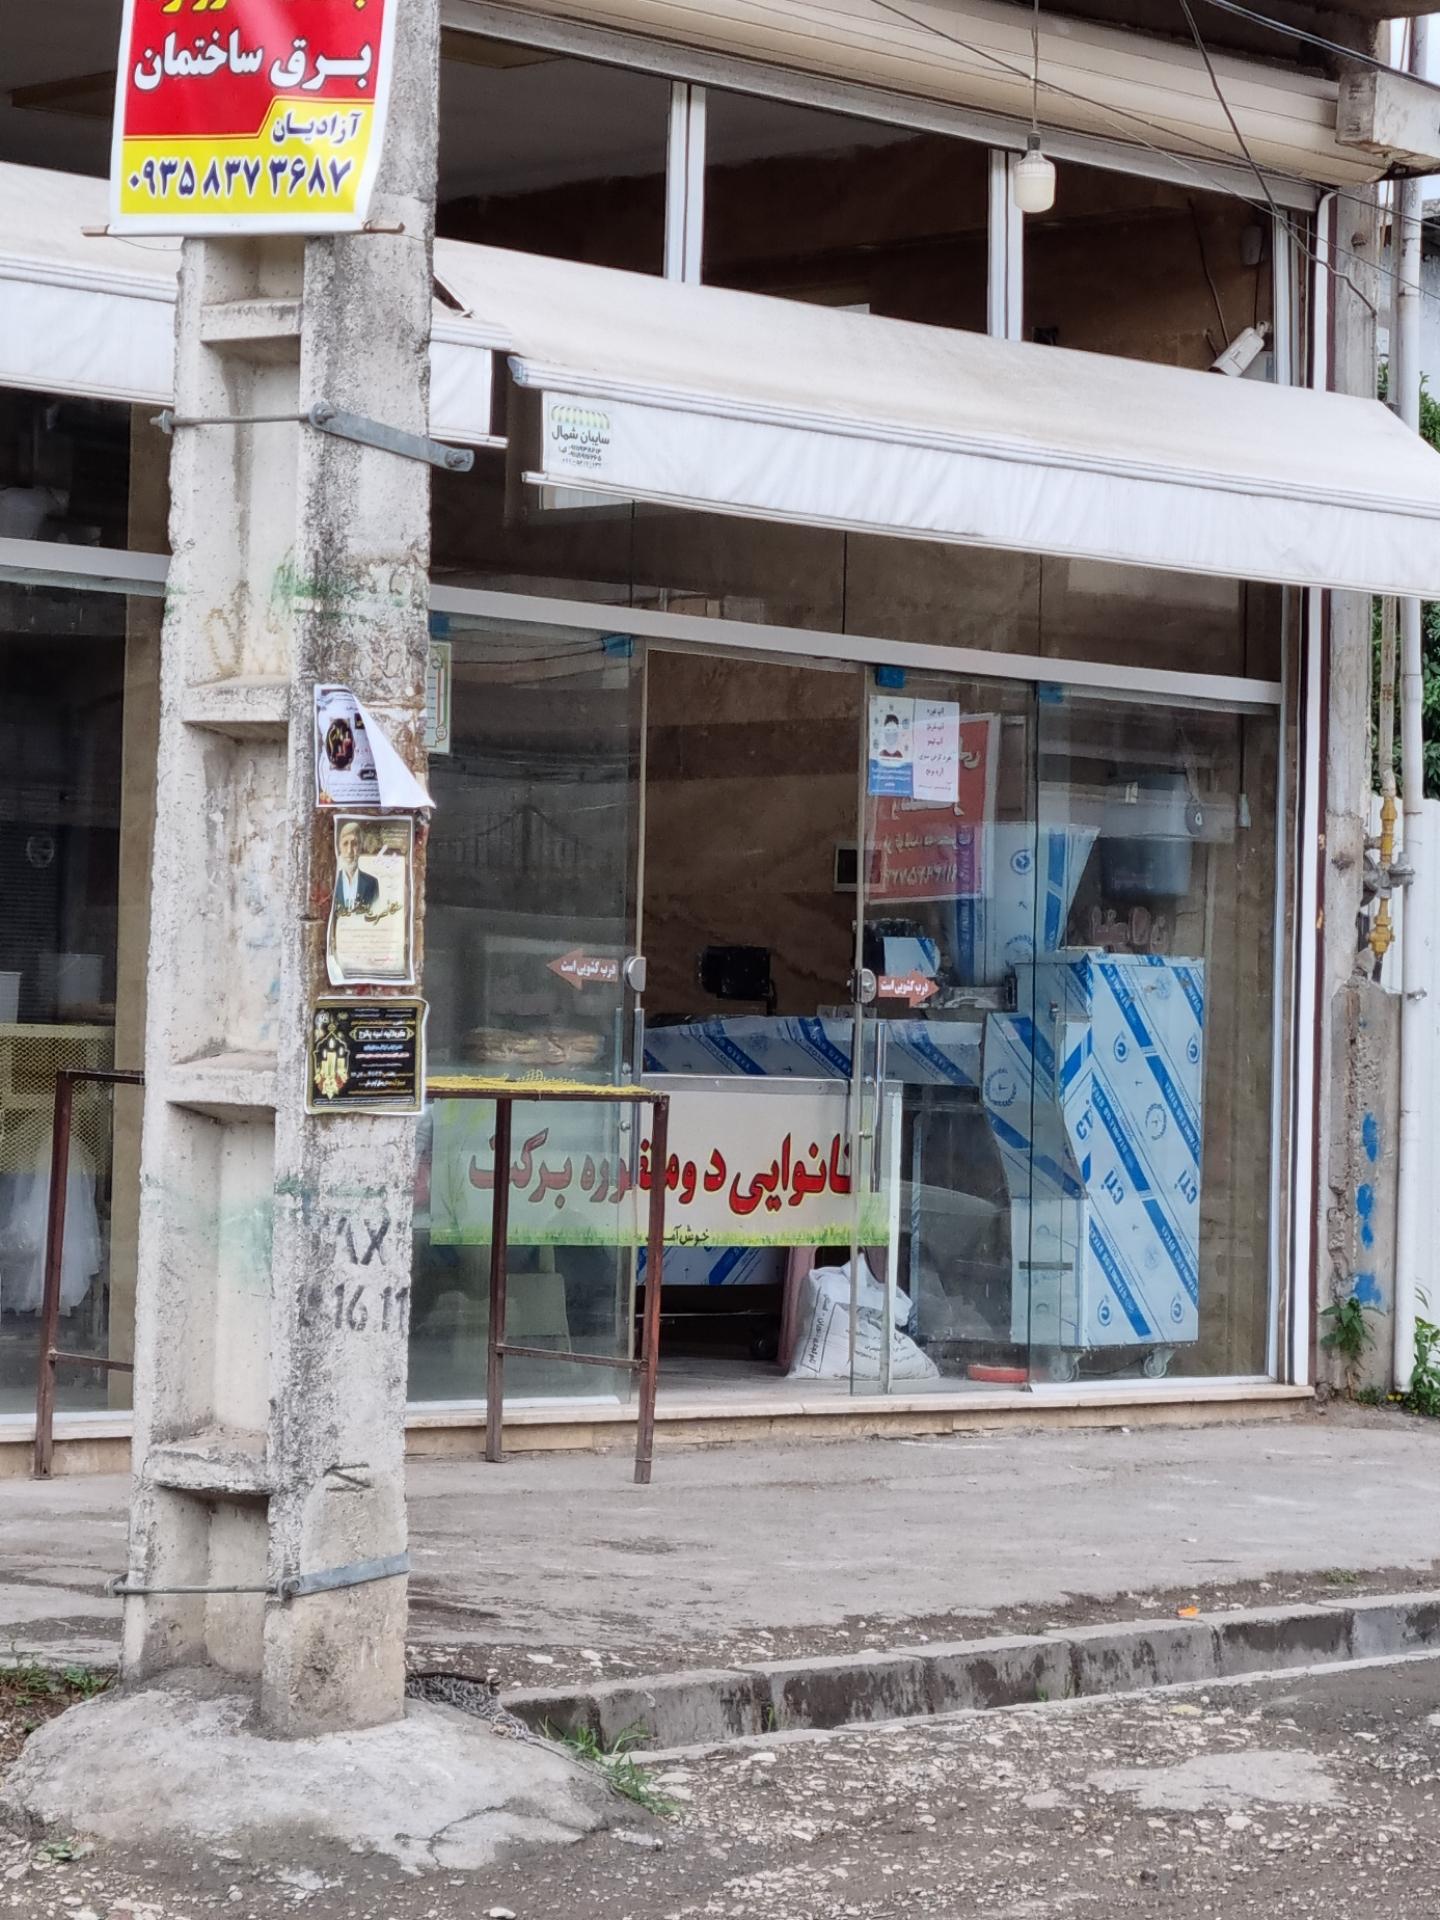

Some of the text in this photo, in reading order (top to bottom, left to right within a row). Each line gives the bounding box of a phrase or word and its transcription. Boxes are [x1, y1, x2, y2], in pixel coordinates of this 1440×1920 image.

[133, 28, 372, 90] برق ساختمان
[272, 112, 362, 144] آزادیان
[551, 424, 610, 446] سایبان شمال
[469, 1128, 573, 1210] برکت
[680, 1223, 709, 1245] خوش
